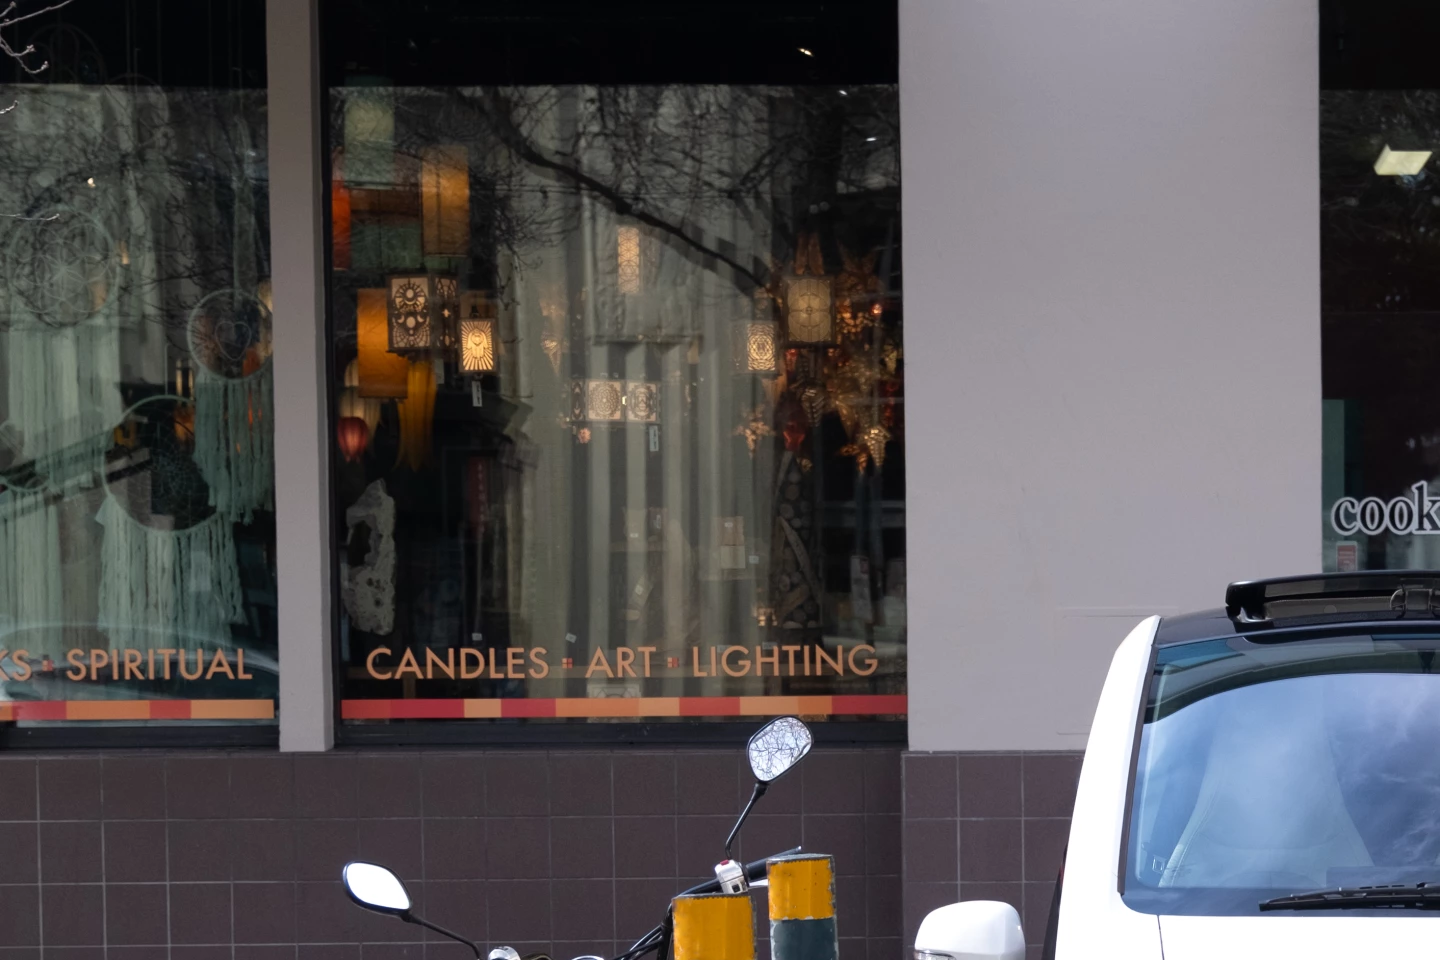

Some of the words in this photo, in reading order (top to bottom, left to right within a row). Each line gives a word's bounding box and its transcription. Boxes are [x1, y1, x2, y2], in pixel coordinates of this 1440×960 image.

[66, 648, 253, 681] SPIRITUAL
[366, 647, 550, 681] CANDLES
[585, 646, 656, 679] ART
[693, 644, 878, 676] LIGHTING
